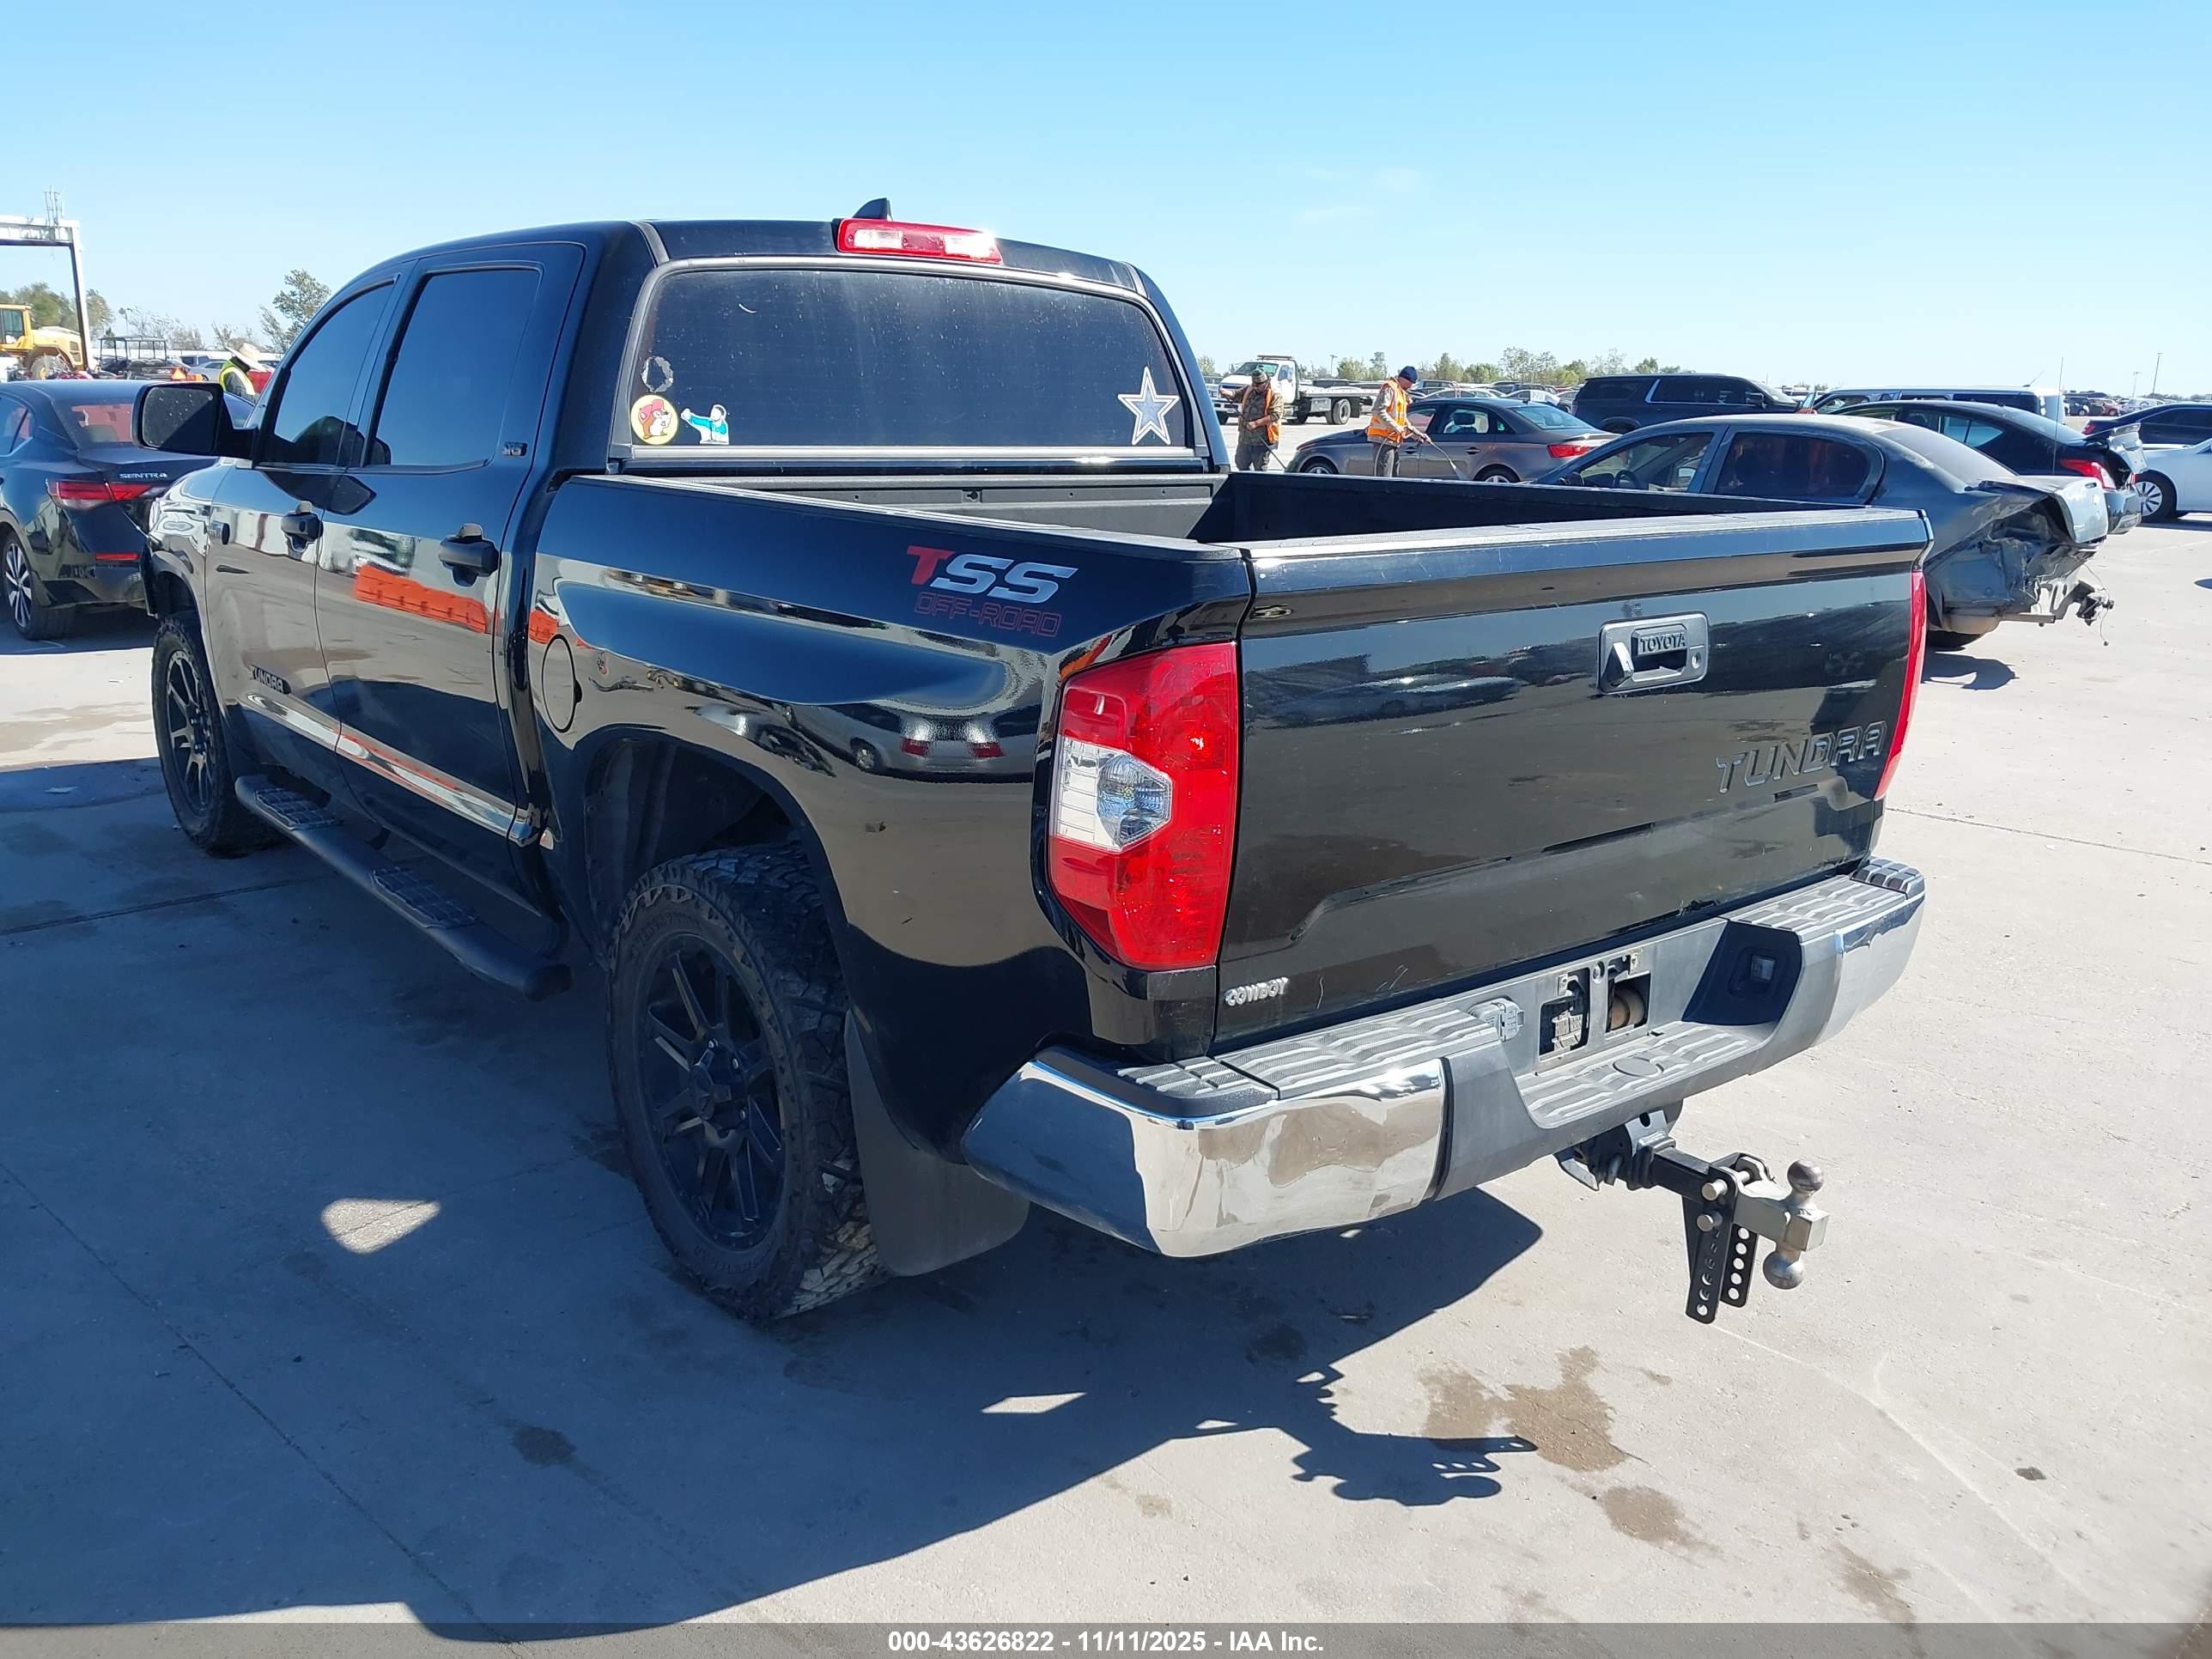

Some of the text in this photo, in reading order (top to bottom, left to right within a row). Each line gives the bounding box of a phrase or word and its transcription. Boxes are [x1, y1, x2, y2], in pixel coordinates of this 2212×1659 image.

[907, 545, 1079, 603] TSS
[914, 592, 1062, 637] OFF-ROAD
[1639, 633, 1686, 653] TOYOTA
[1717, 720, 1887, 793] TUNDRA
[1224, 977, 1289, 1006] COWBOY
